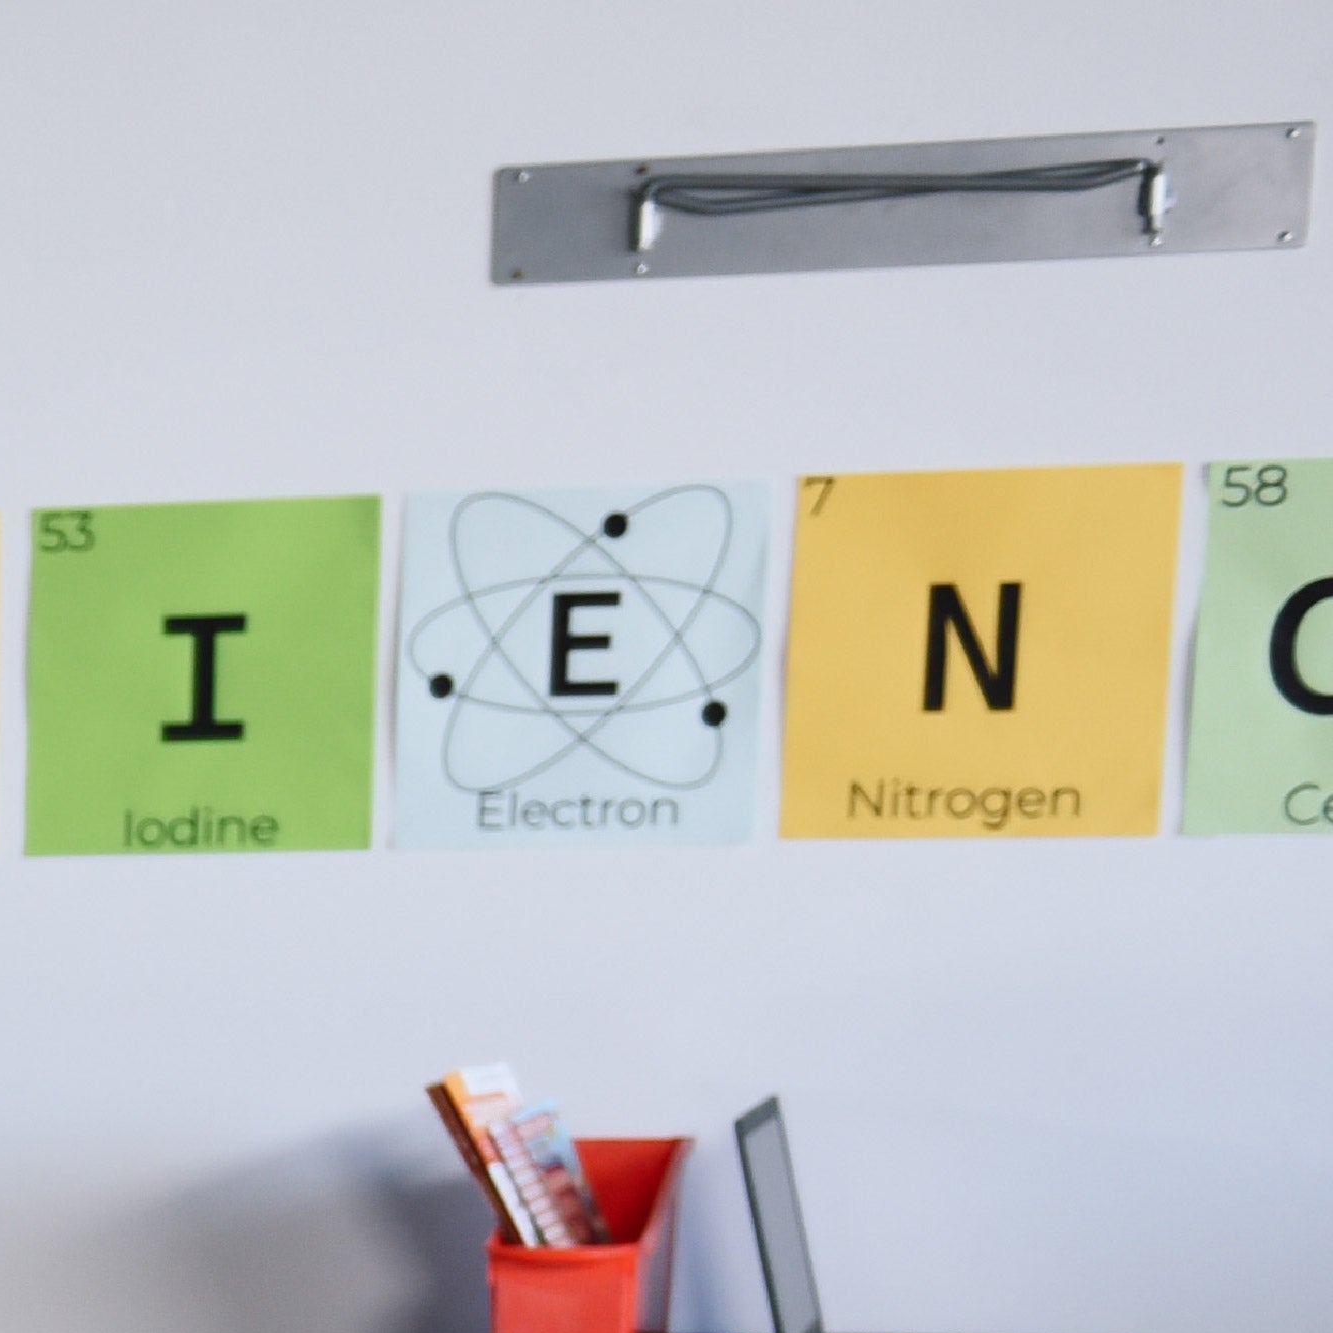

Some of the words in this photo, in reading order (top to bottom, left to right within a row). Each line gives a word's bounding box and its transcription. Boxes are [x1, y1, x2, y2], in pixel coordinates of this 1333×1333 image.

[803, 476, 836, 518] 7
[1221, 464, 1288, 508] 58
[39, 510, 96, 553] 53
[549, 591, 621, 698] E
[922, 581, 1022, 713] N
[159, 613, 247, 743] I
[476, 789, 680, 832] Electron
[847, 776, 1083, 832] Nitrogen
[122, 806, 281, 848] Iodine
